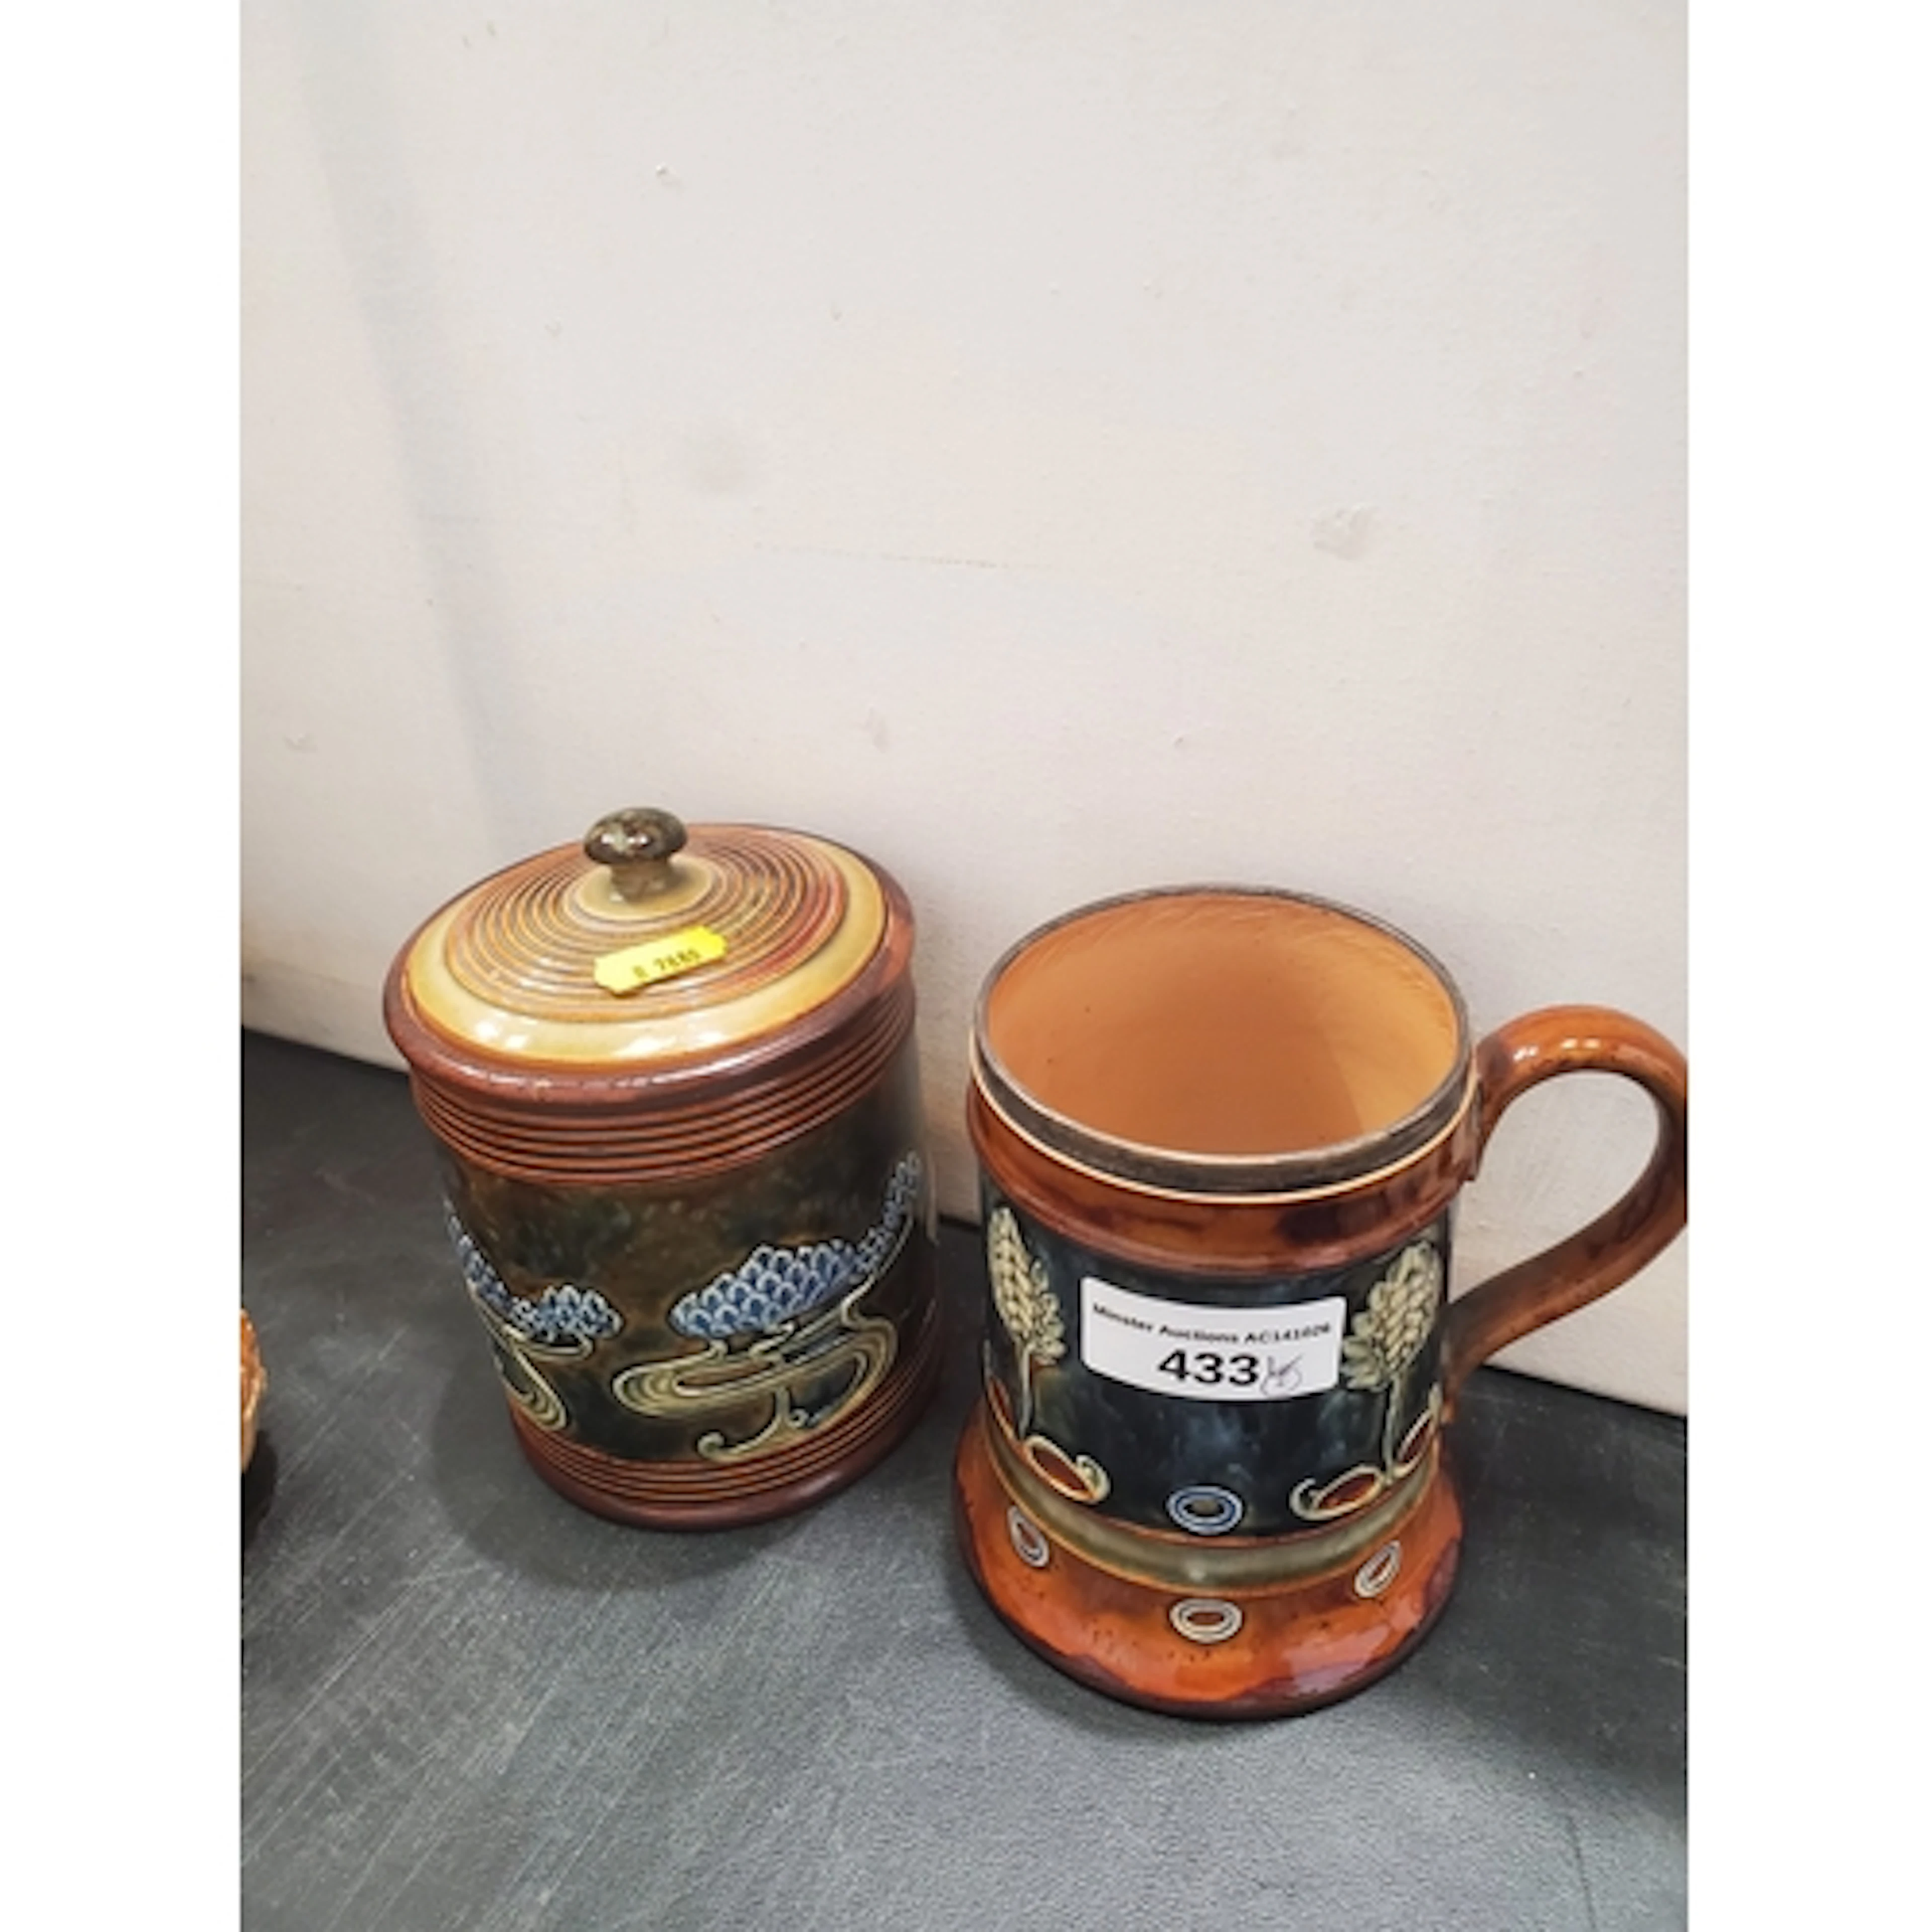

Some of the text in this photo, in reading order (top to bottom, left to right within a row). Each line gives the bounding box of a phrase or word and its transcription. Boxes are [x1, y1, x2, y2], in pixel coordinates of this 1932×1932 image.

[1093, 1302, 1154, 1332] Minster
[1159, 1324, 1239, 1344] Auctions
[1158, 1349, 1259, 1387] 433
